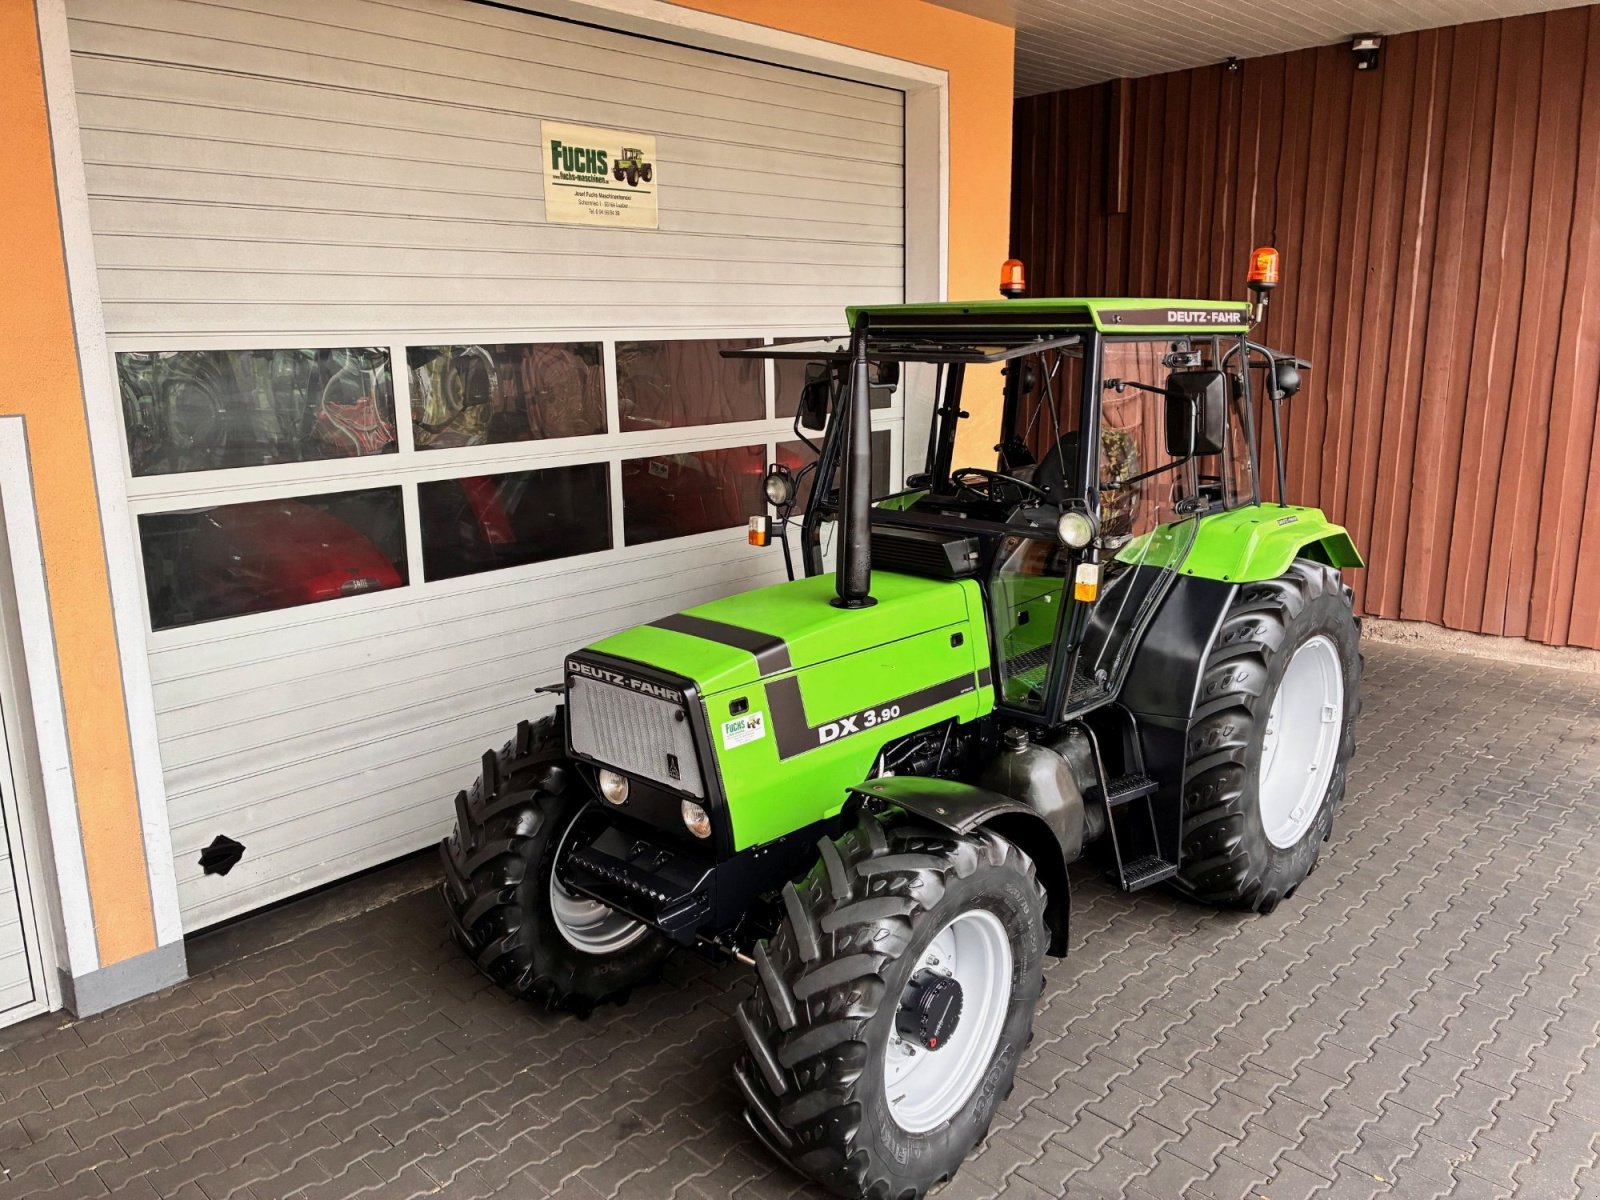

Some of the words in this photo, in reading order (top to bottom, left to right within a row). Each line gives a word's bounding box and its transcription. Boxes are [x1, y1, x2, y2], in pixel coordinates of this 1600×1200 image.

[551, 139, 608, 176] FUCHS
[725, 719, 746, 735] FUCHS
[818, 716, 860, 744] DX
[863, 705, 900, 728] 3.90
